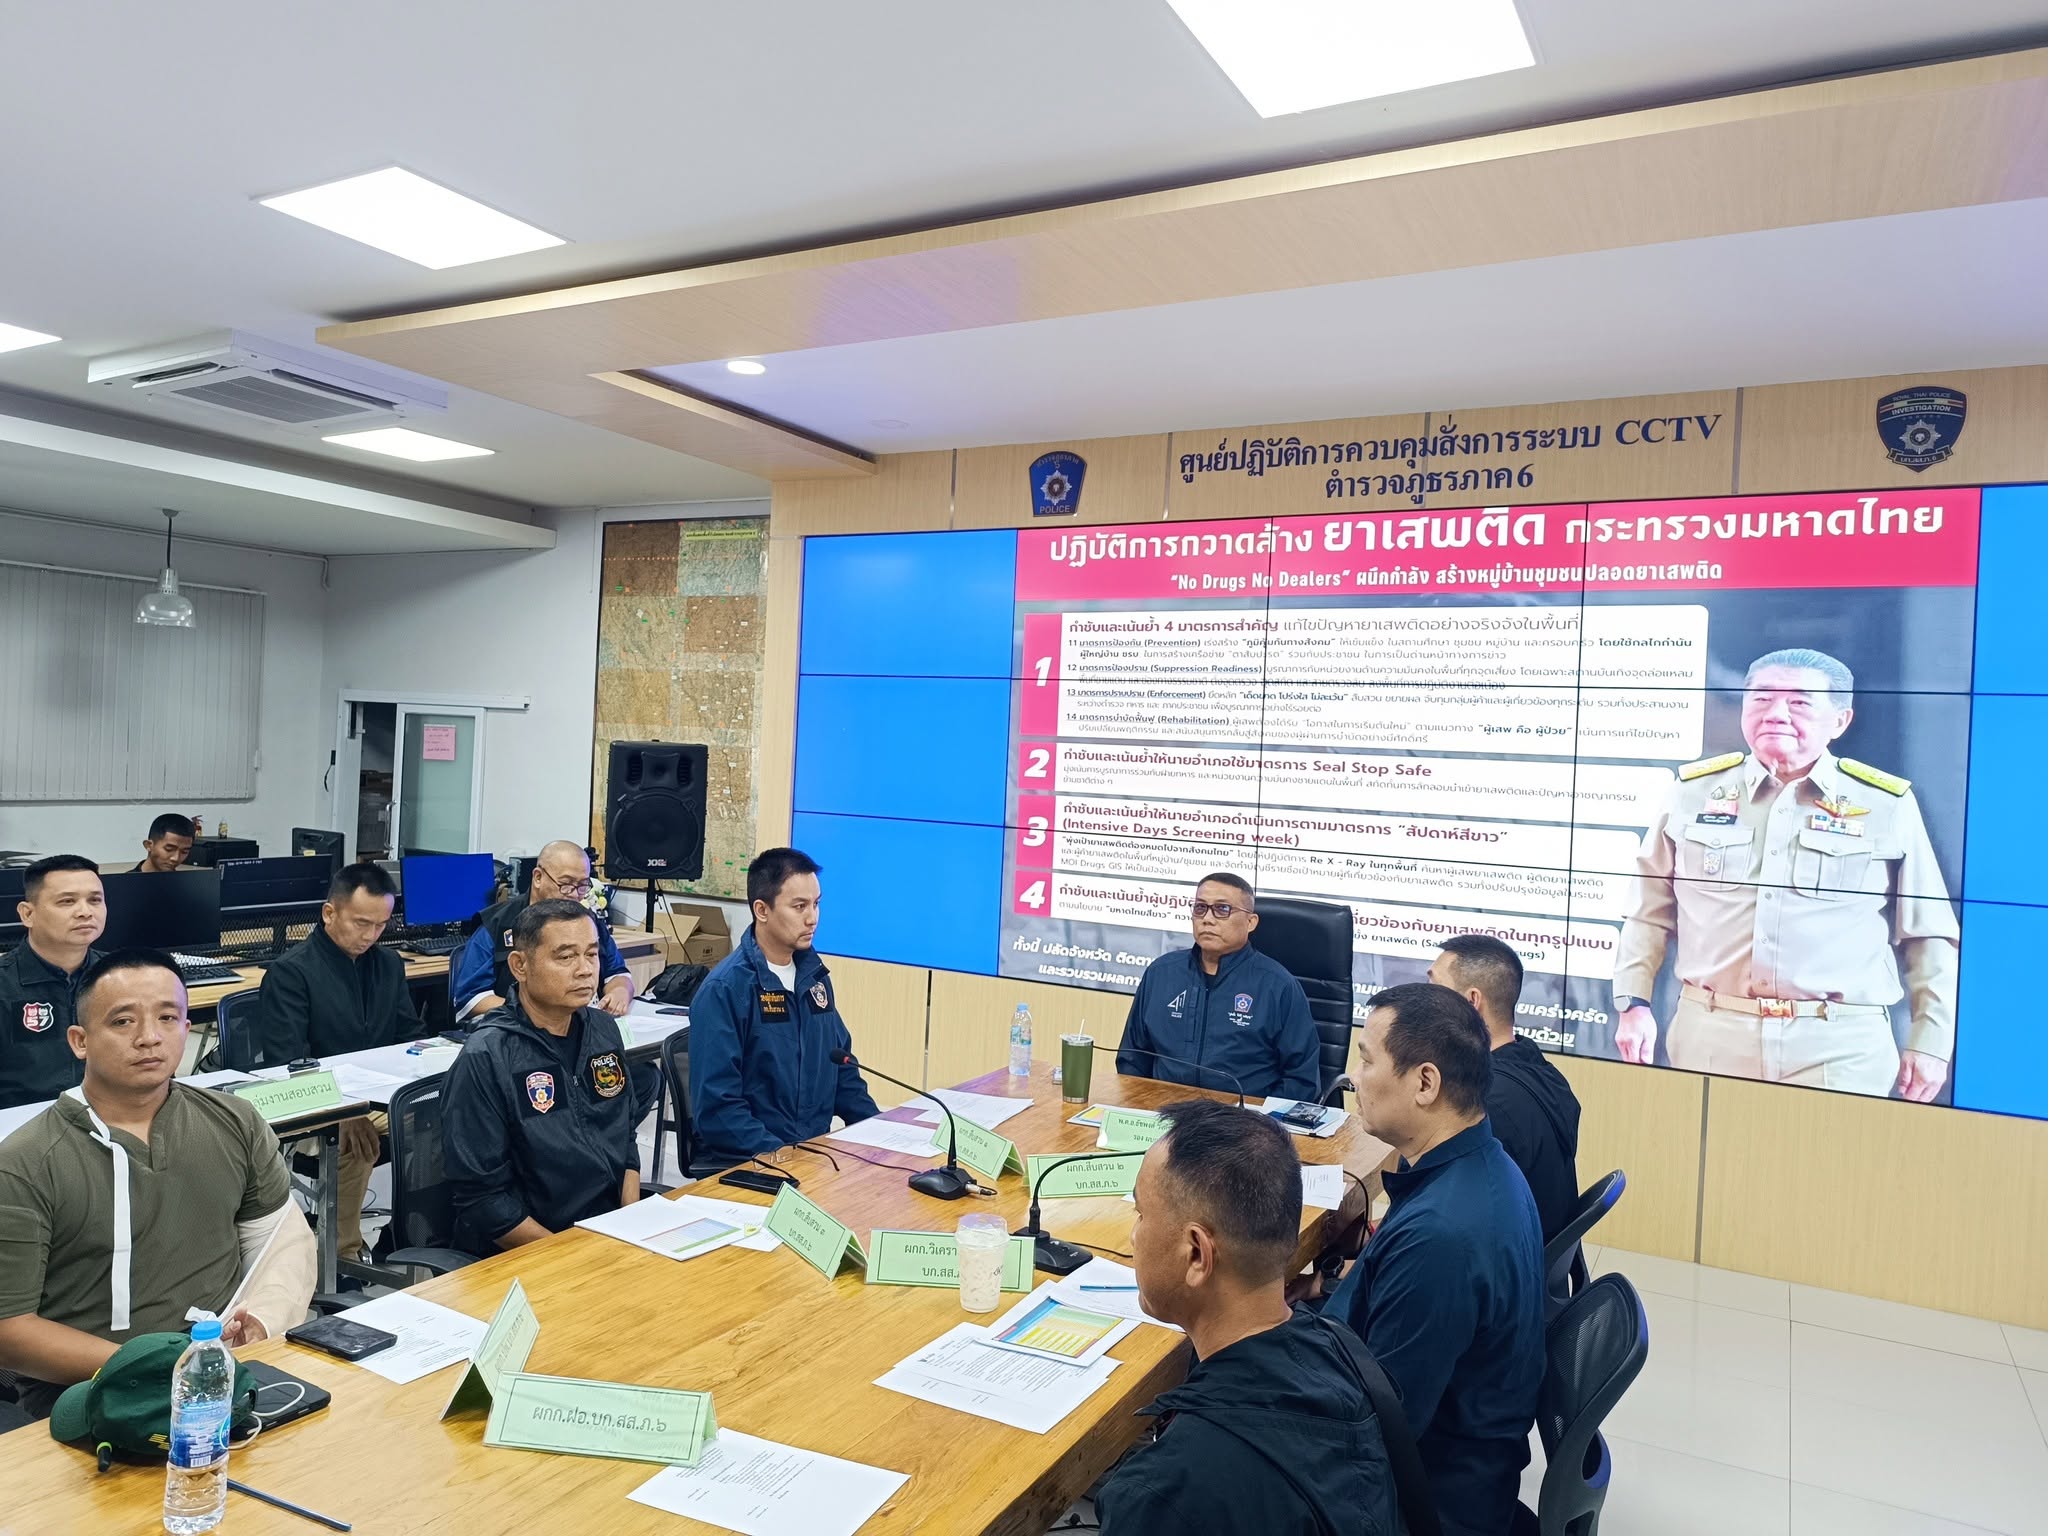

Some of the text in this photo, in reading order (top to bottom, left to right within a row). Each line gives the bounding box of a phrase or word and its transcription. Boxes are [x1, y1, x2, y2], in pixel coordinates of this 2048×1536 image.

[1891, 404, 1952, 416] INVESTIGATION
[1179, 413, 1723, 483] ศูนย์ปฏิบัติการควบคุมสั่งการระบบ CCTV
[1325, 462, 1534, 505] ตำรวจภูธรภาค6
[1039, 504, 1071, 515] POLICE
[1050, 497, 1943, 568] ปฏิบัติการกวาดล้าง ยาเสพติด กระทรวงมหาดไทย
[1202, 573, 1246, 592] Drugs
[1251, 572, 1273, 589] No
[1356, 566, 1429, 587] ผนึกกำลัง
[1435, 561, 1722, 590] สร้างหมู่บ้านชุมชนปลอดยาเสพติด
[1069, 613, 1579, 632] กำชับและเน้นย้ำ 4 มาตรการสำคัญ แก้ไขปัญหายาเสพติดอย่างจริงจังในพื้นที่
[1144, 639, 1201, 648] (Prevention)
[1034, 656, 1053, 687] 1
[1150, 664, 1209, 674] (Suppression
[1211, 664, 1263, 674] Readiness)
[1146, 690, 1206, 699] (Enforcement)
[1157, 715, 1230, 726] (Rehabilitation)
[1023, 748, 1051, 779] 2
[1313, 760, 1346, 773] Seal
[1351, 762, 1389, 777] Stop
[1395, 764, 1432, 777] Safe
[1022, 815, 1048, 847] 3
[1062, 818, 1300, 848] (Intensive Days Screening week)
[1060, 857, 1078, 867] MOI
[1080, 859, 1106, 870] Drugs
[1108, 862, 1122, 871] GIS
[1310, 855, 1323, 864] Re
[1327, 857, 1334, 865] X
[1346, 859, 1366, 869] Ray
[1018, 880, 1047, 910] 4
[904, 1242, 958, 1257] ผกก.วิเครา
[532, 1405, 668, 1433] ผกก.ฝอ.บก.สส.ภ.๖
